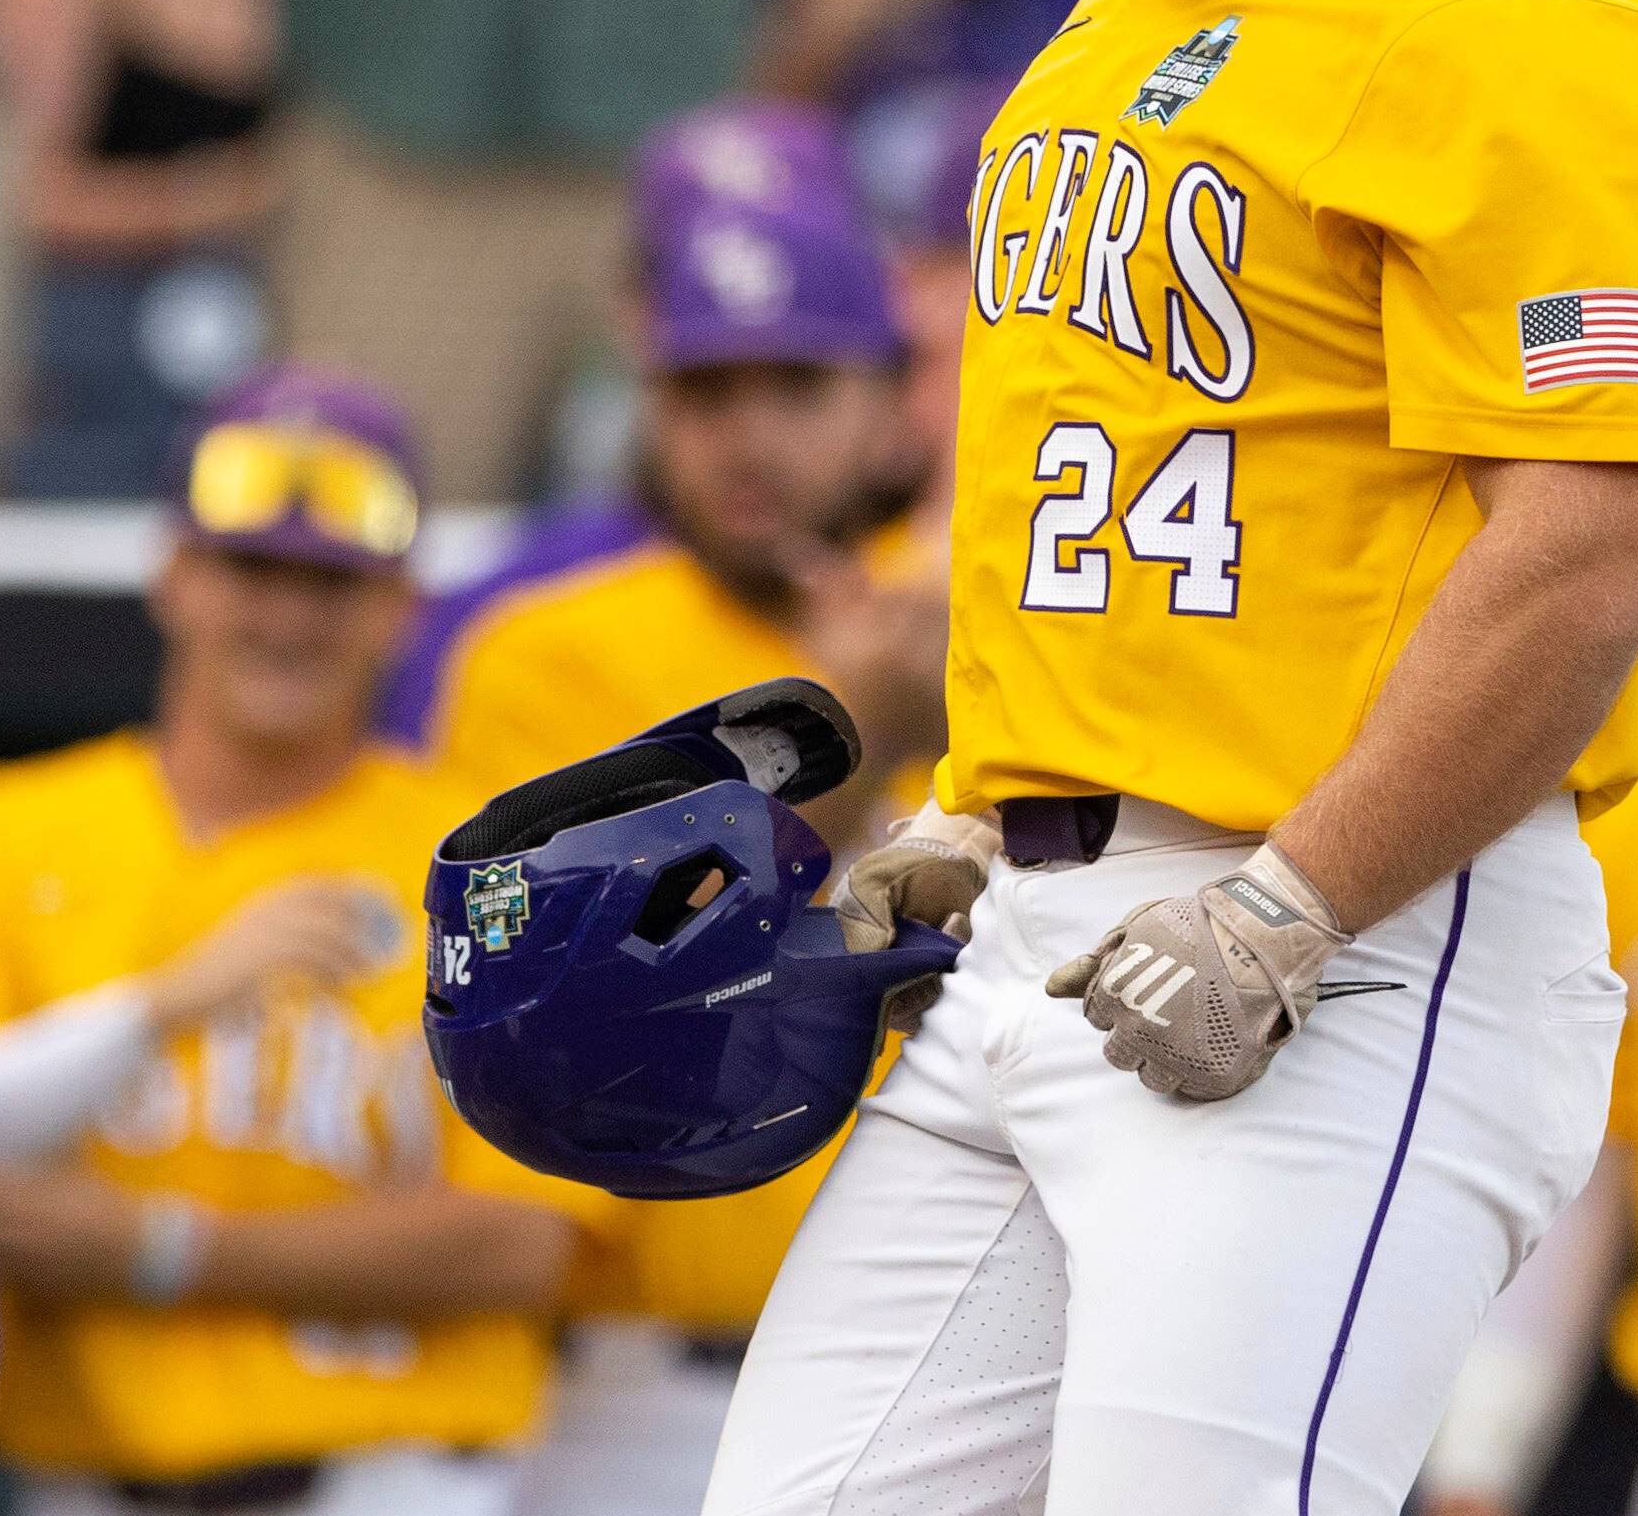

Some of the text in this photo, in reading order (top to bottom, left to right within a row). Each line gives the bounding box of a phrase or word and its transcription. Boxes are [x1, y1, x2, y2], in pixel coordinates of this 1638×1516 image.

[1018, 421, 1243, 619] 24
[1231, 880, 1282, 918] marucci
[443, 935, 472, 986] 24
[704, 970, 773, 1009] marucci
